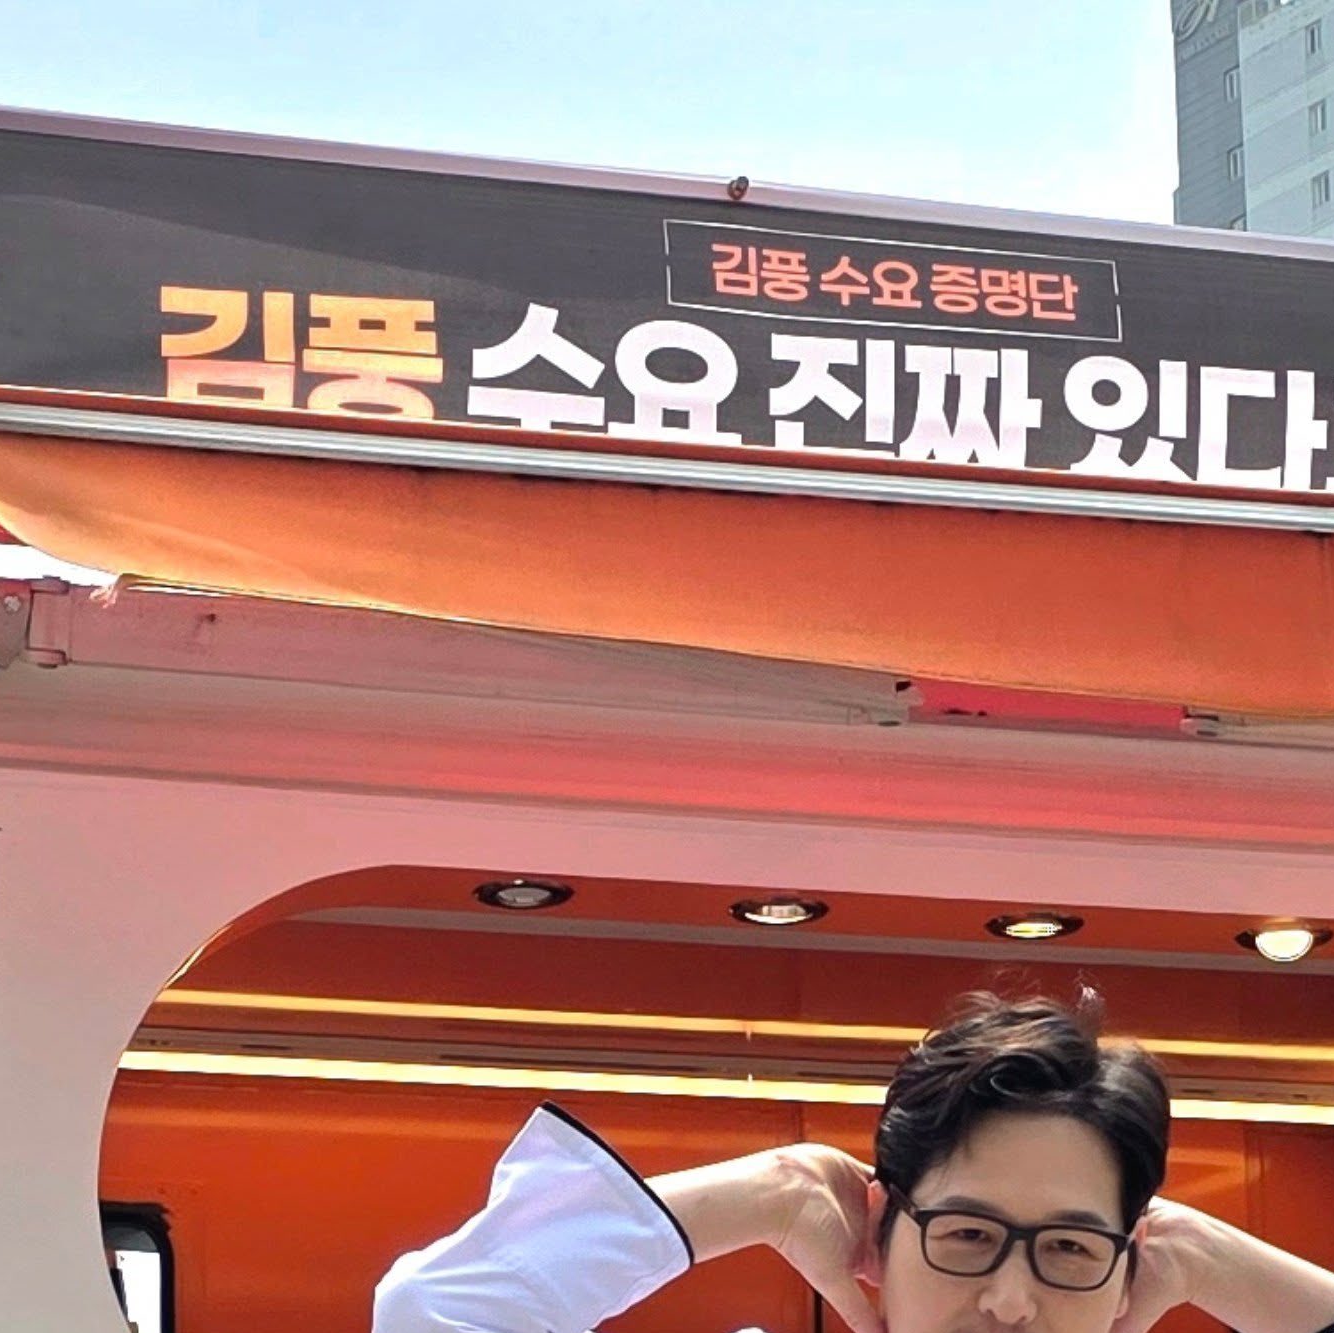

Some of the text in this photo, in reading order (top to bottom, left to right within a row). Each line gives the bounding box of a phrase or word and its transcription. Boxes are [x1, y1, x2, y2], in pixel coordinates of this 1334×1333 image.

[711, 244, 1079, 321] 김풍 수요 증명단
[161, 286, 443, 420] 김풍
[467, 302, 742, 446] 수요
[769, 332, 1042, 469] 진짜
